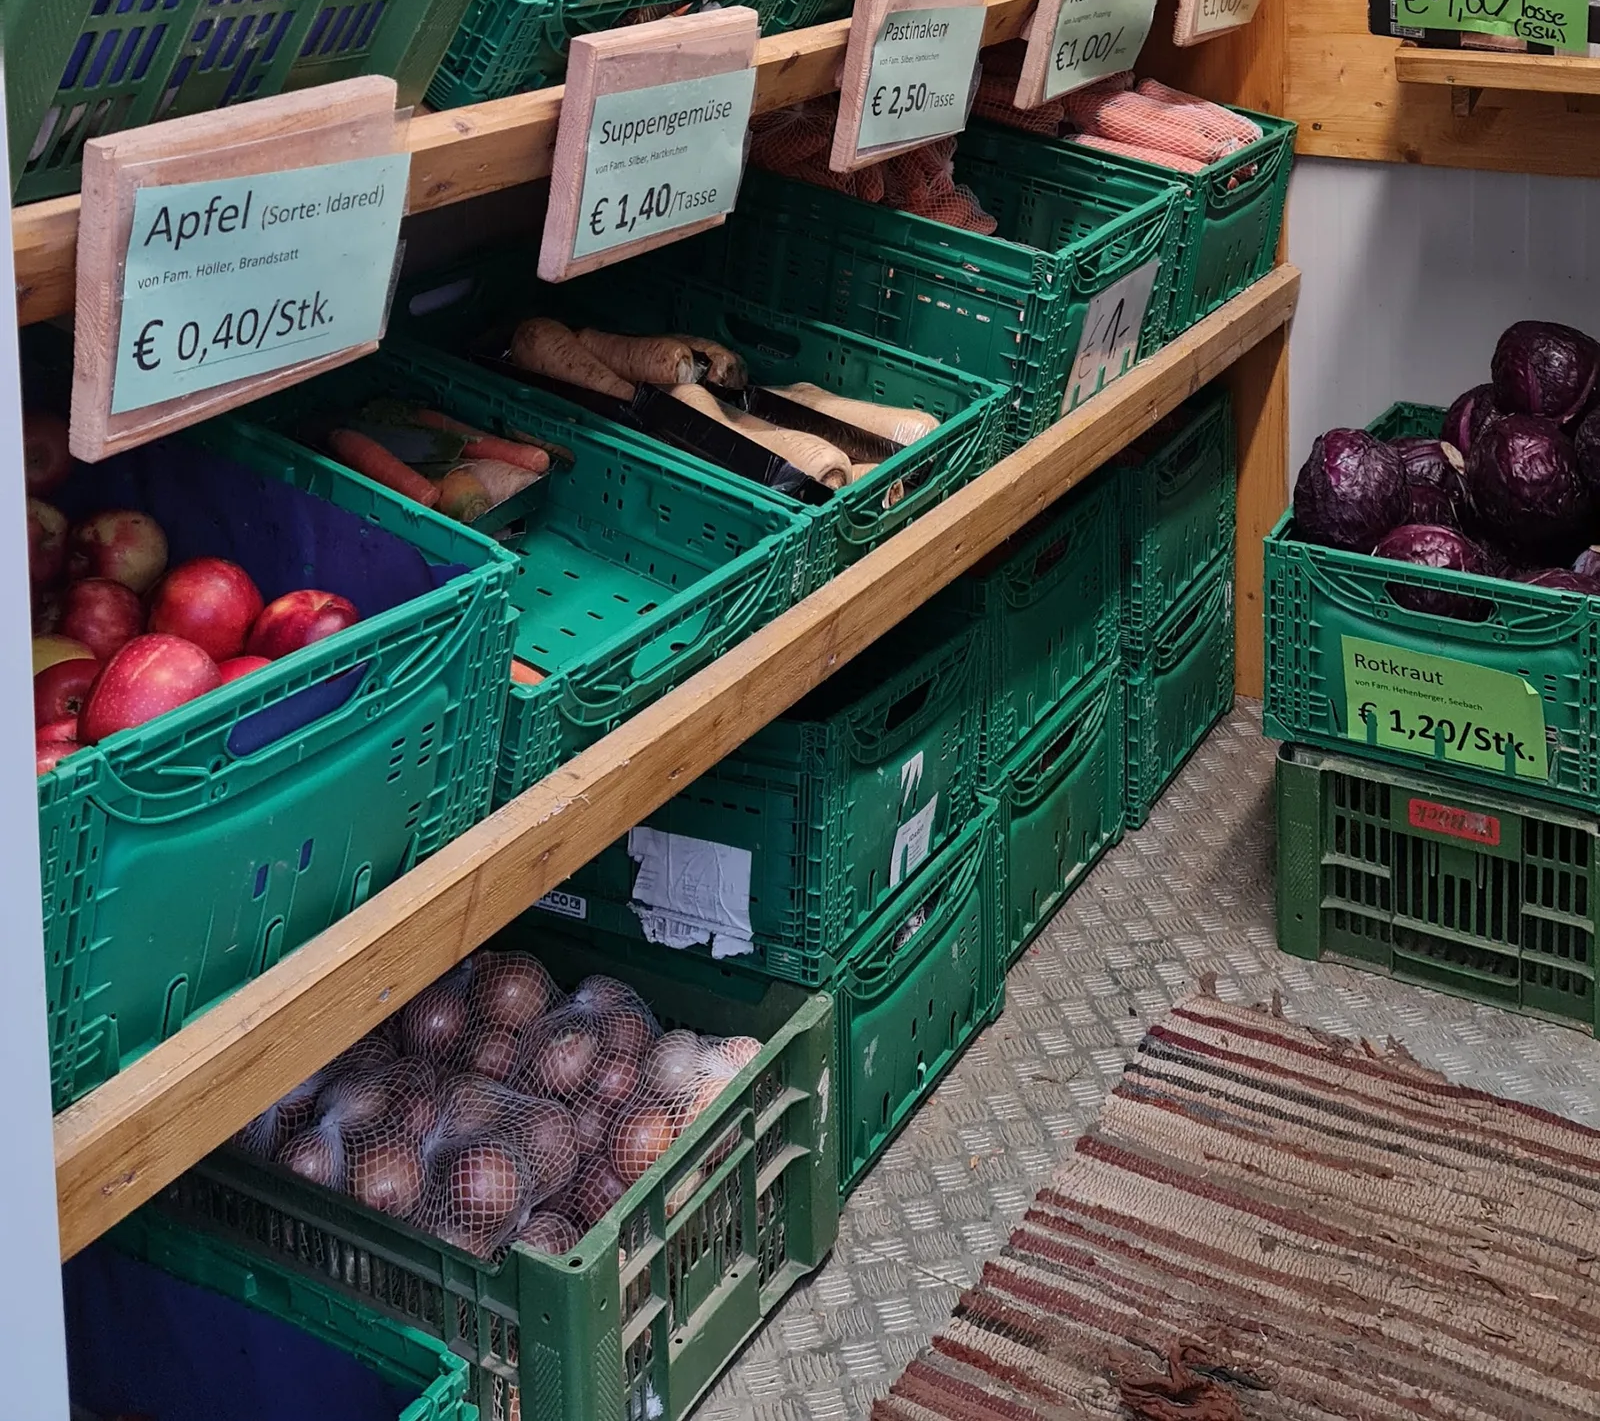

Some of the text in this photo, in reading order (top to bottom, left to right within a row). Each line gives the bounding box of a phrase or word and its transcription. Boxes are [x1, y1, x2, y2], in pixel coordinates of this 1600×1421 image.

[871, 82, 955, 119] € 2,50/Tasse
[600, 100, 732, 146] Suppengemüse
[595, 164, 608, 175] von
[609, 160, 626, 171] Fam.
[144, 184, 385, 250] Apfel (Sorte: Idared)
[589, 183, 717, 236] € 1,40/Tasse
[137, 248, 299, 290] von Fam. Höller, Brandstatt
[132, 290, 334, 372] € 0,40/Stk.
[1354, 653, 1444, 686] Rotkraut
[1355, 679, 1370, 688] von
[1372, 681, 1391, 692] Fam.
[1449, 697, 1483, 711] Seebach
[1389, 708, 1536, 762] 1,20/Stk.
